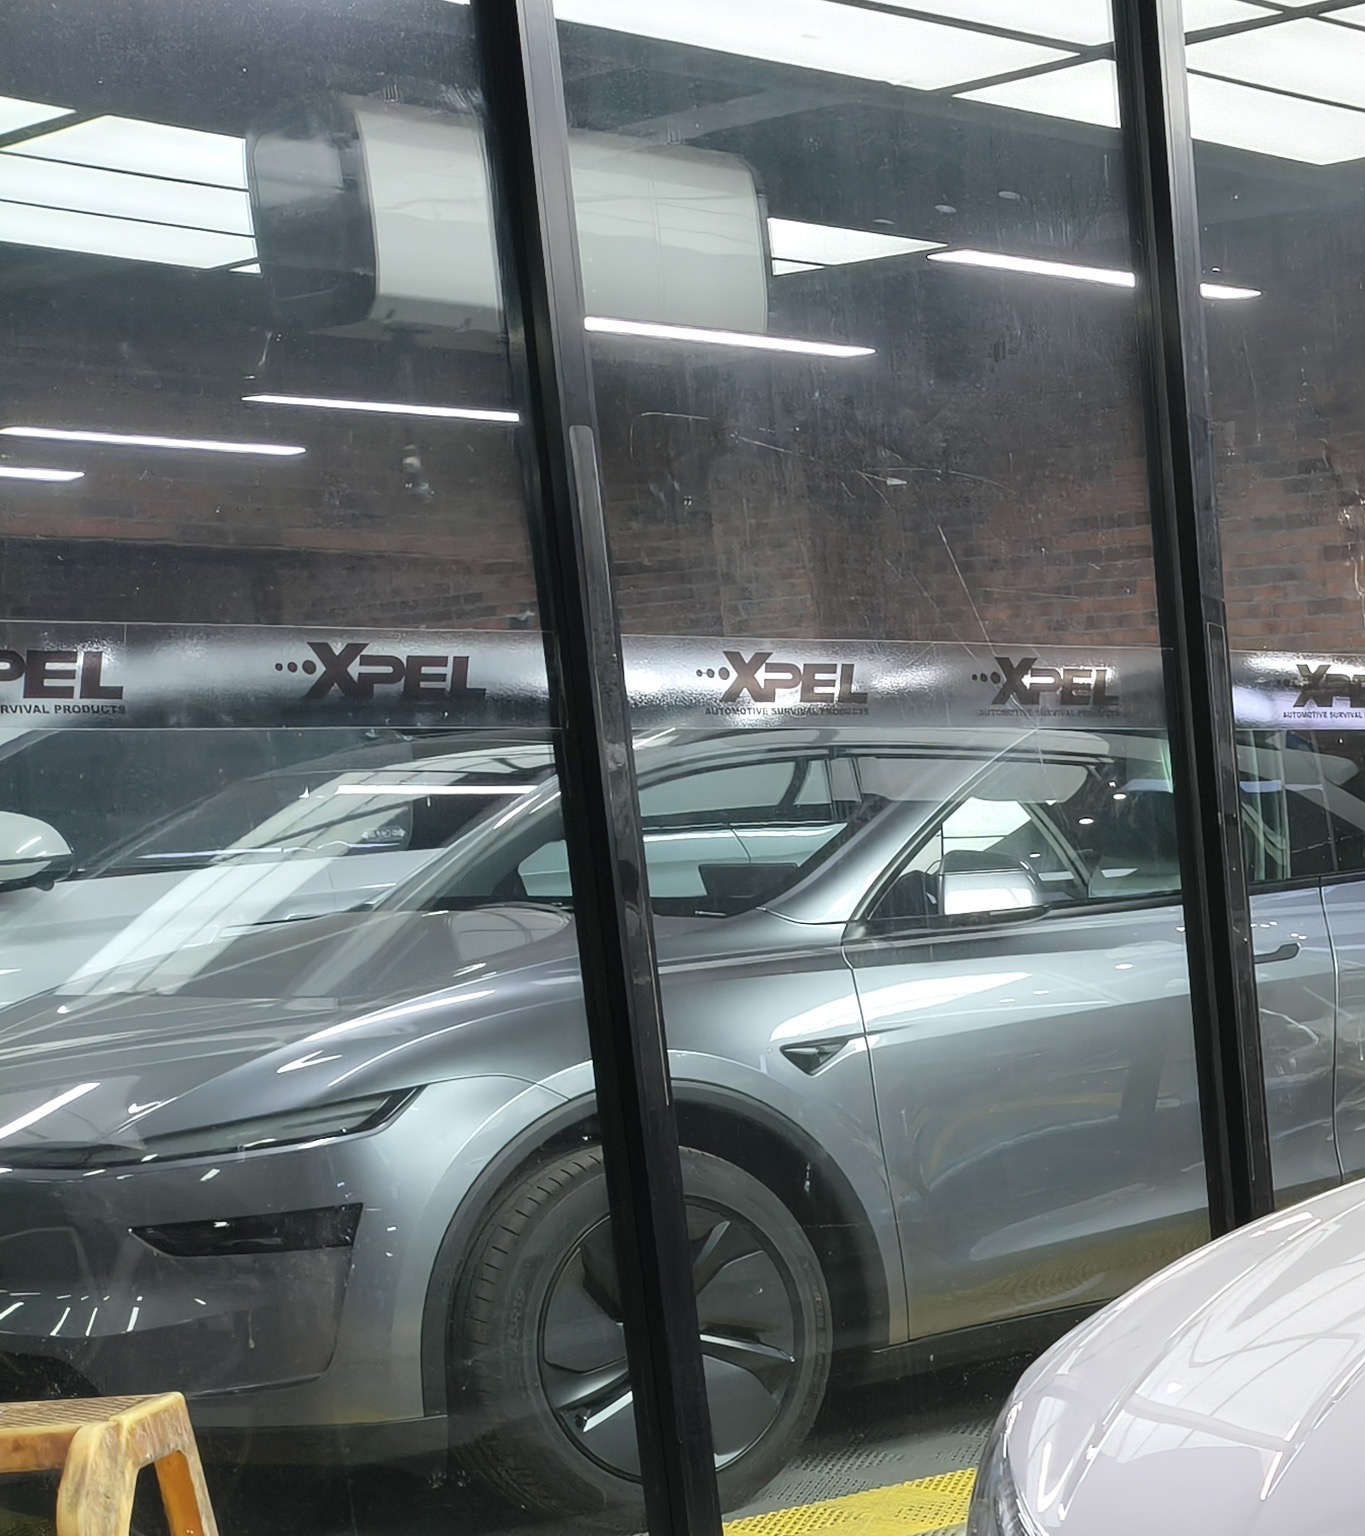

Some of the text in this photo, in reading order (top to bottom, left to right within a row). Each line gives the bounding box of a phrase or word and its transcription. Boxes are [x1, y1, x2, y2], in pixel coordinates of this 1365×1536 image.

[302, 642, 487, 700] XPEL
[719, 651, 868, 703] XPEL
[991, 657, 1120, 705] XPEL
[54, 704, 126, 715] PRODUCTS
[705, 707, 769, 716] AUTOMOTIVE
[771, 707, 818, 717] SURVIVAL
[1283, 711, 1328, 719] AUTOMOTIVE
[1329, 711, 1362, 719] SURVIVAL
